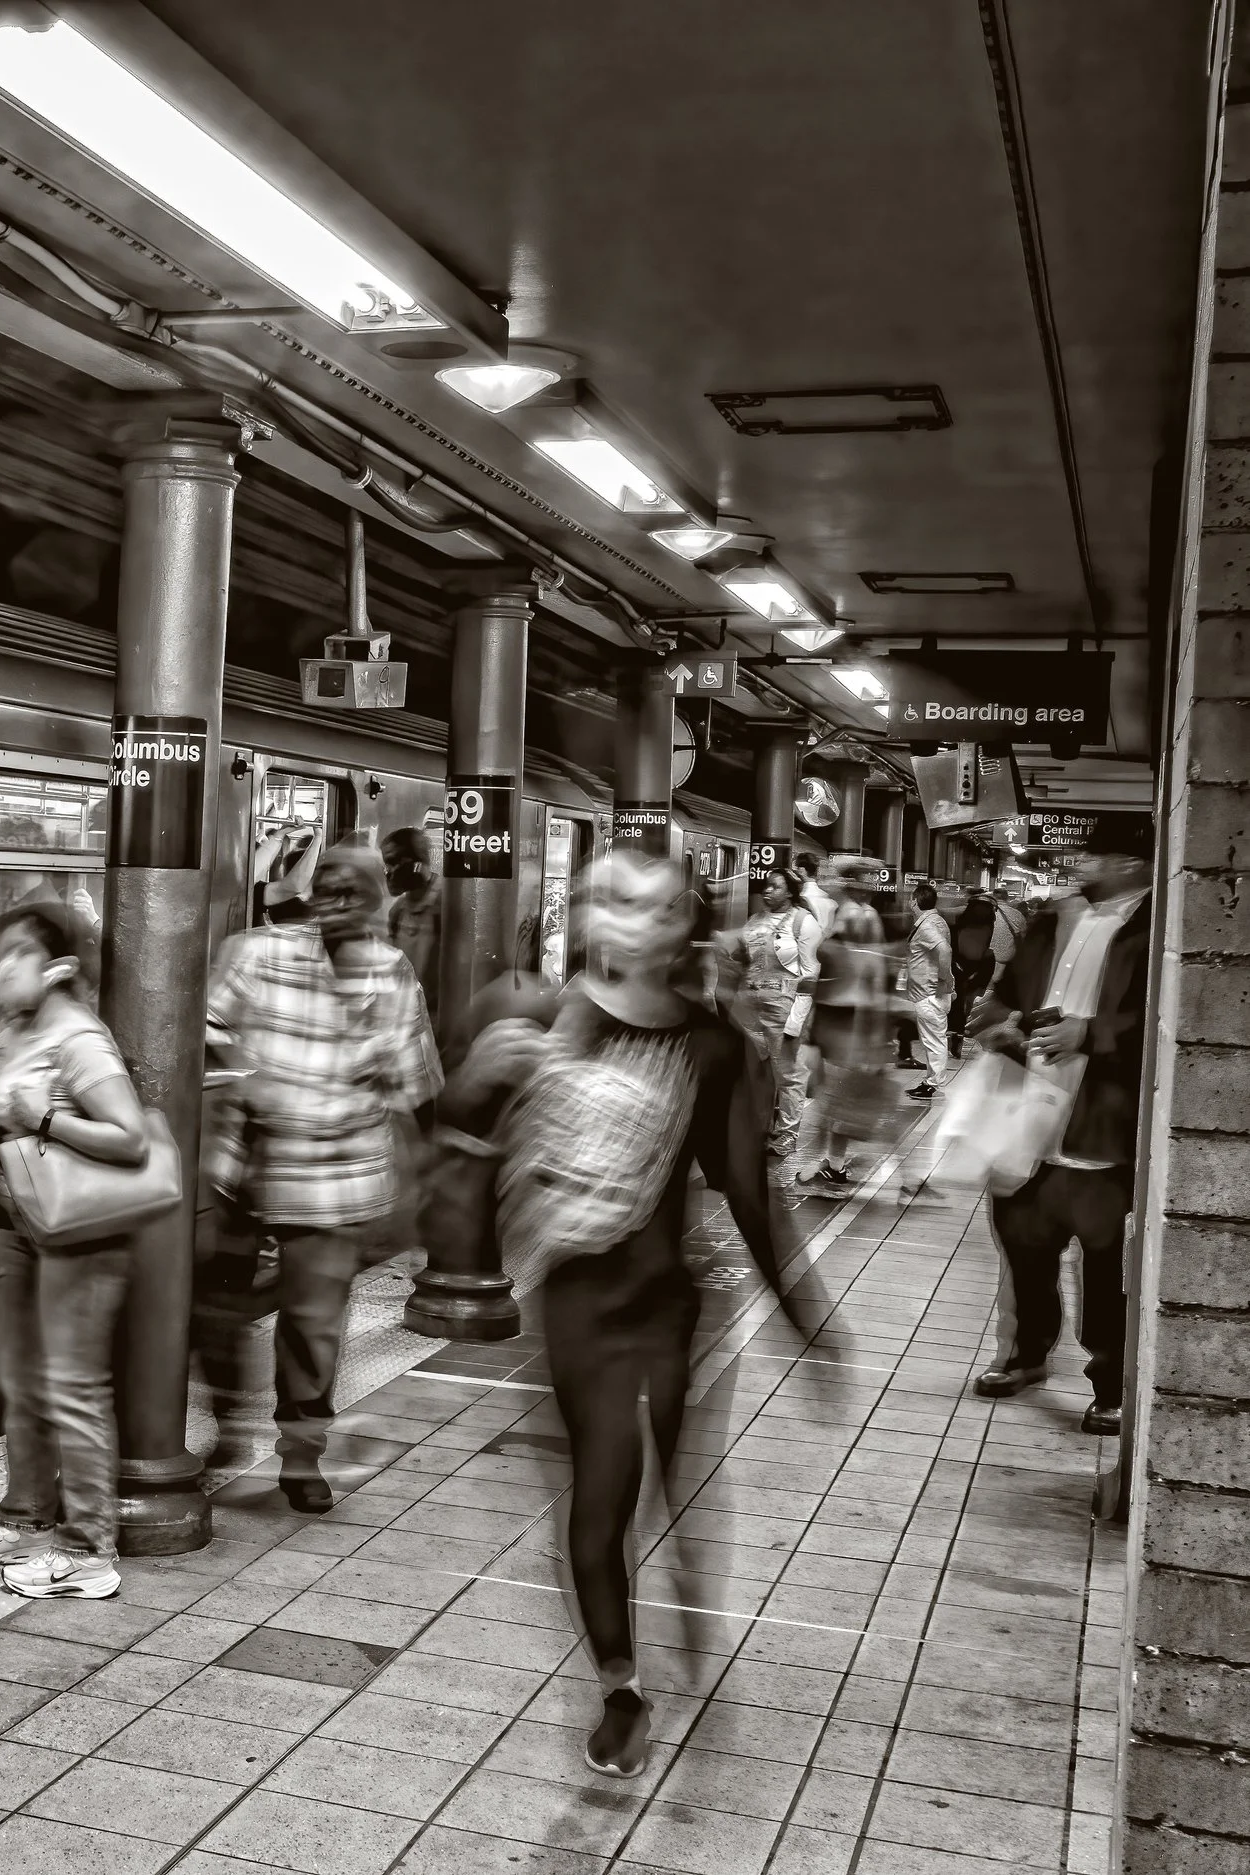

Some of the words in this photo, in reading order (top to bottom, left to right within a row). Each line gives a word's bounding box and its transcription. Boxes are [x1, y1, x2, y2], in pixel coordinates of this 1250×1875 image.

[925, 702, 1029, 726] Boarding
[1034, 706, 1085, 723] area
[444, 790, 484, 825] 59
[613, 812, 667, 825] Columbus
[1043, 814, 1059, 824] 60
[613, 826, 643, 838] Circle
[1042, 824, 1082, 835] Central
[444, 829, 511, 854] Street
[751, 845, 776, 865] 59
